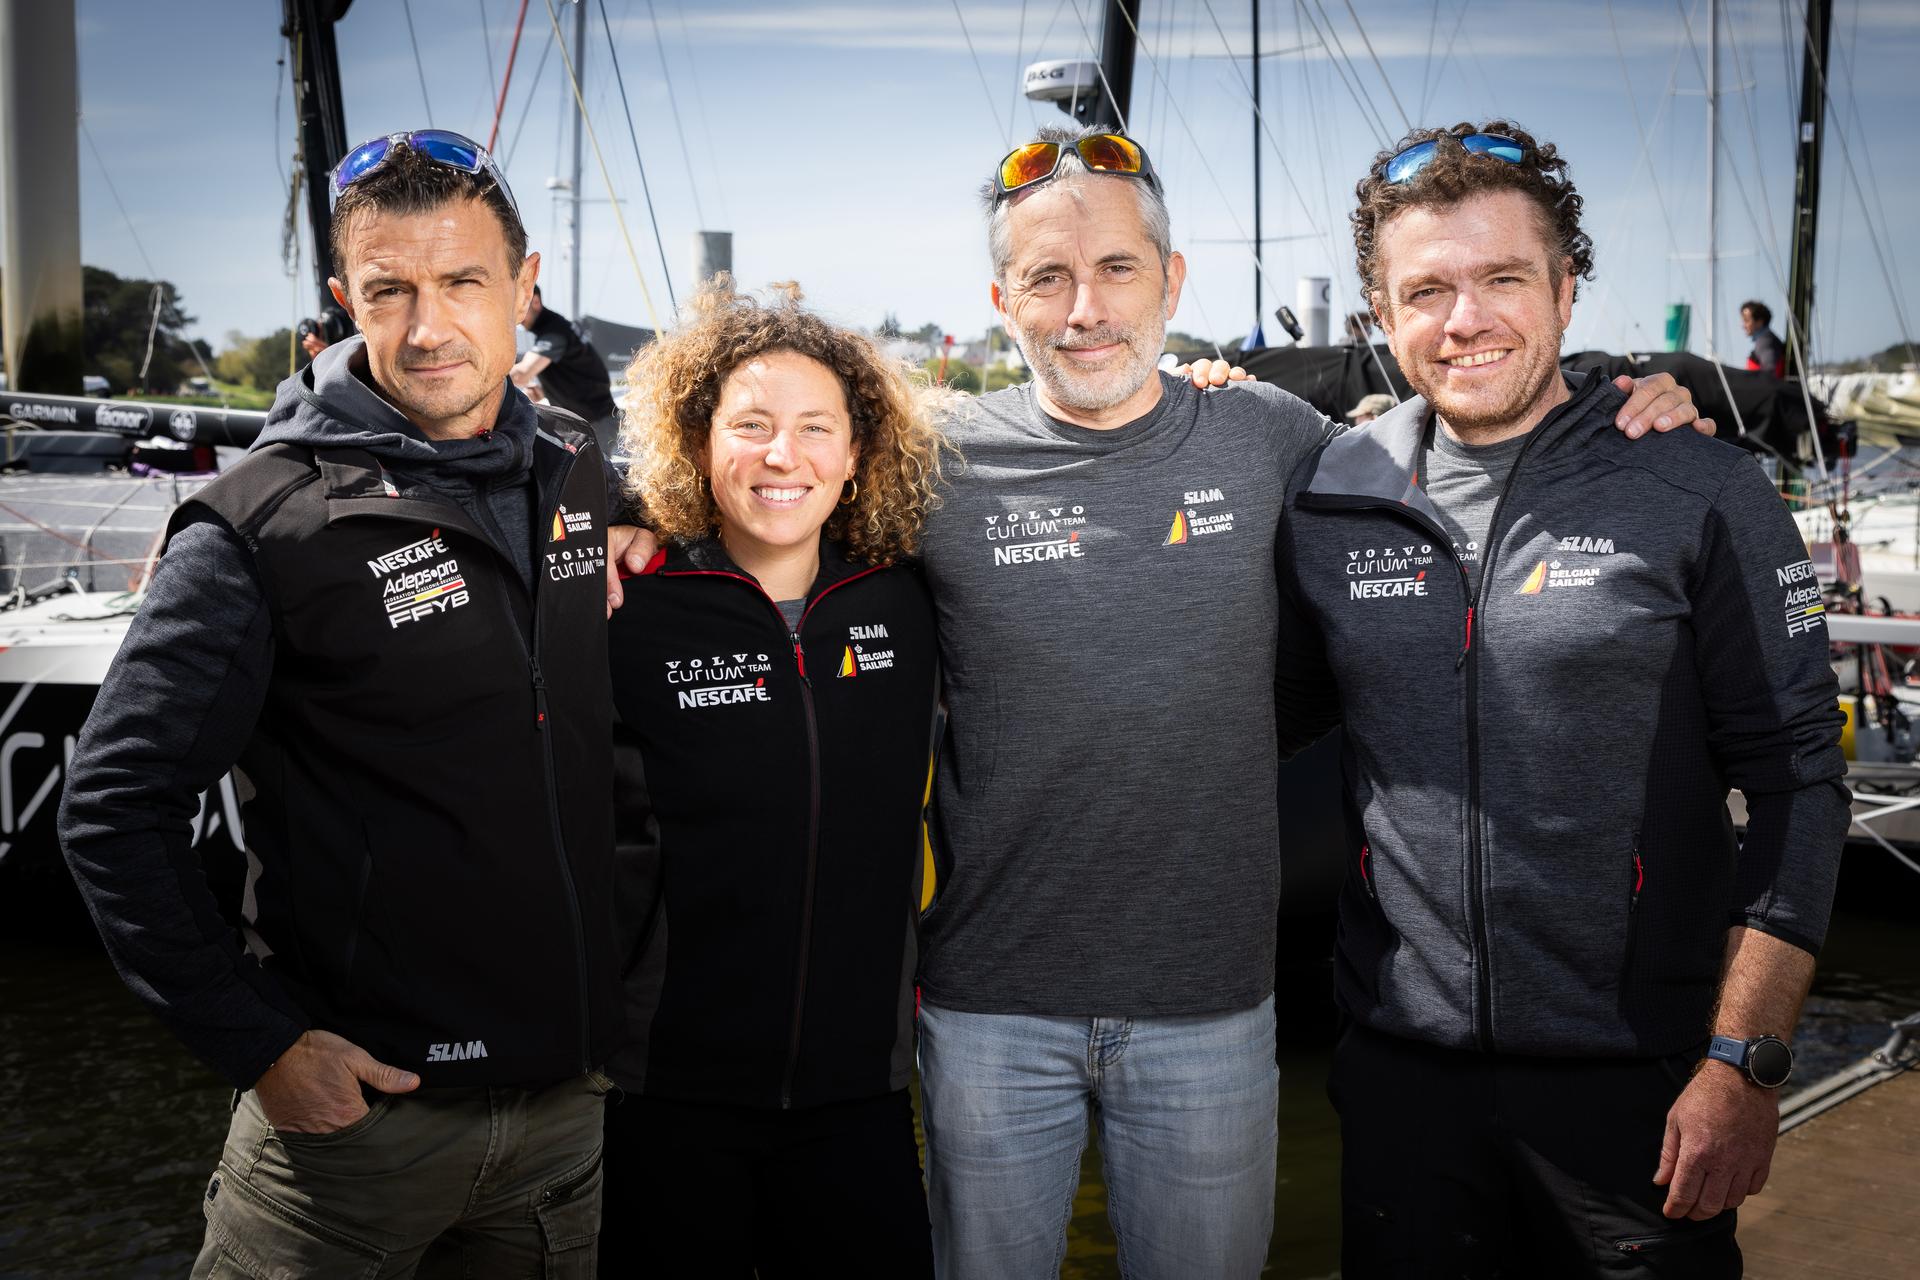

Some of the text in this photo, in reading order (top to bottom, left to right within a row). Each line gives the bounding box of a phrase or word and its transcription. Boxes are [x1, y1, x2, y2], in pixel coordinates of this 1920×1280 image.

[10, 403, 77, 423] GARMIN
[1184, 488, 1224, 505] SLAM
[563, 512, 591, 523] BELGIAN
[985, 505, 1084, 525] VOLVO
[1062, 517, 1086, 526] TEAM
[1189, 513, 1234, 527] BELGIAN
[566, 521, 592, 533] SAILING
[1192, 523, 1232, 536] SAILING
[367, 528, 449, 578] NESCAFÉ
[994, 531, 1085, 566] NESCAFÉ
[1348, 544, 1431, 560] VOLVO
[1558, 536, 1615, 554] SLAM
[546, 546, 603, 563] VOLVO
[1413, 556, 1433, 565] TEAM
[1550, 568, 1600, 578] BELGIAN
[1350, 571, 1428, 600] NESCAFÉ
[1549, 577, 1595, 587] SAILING
[389, 590, 470, 629] FFYB
[849, 624, 889, 640] SLAM
[665, 653, 769, 669] VOLVO
[857, 650, 894, 662] BELGIAN
[748, 664, 771, 672] TEAM
[860, 659, 893, 671] SAILING
[678, 677, 771, 709] NESCAFÉ
[427, 1040, 488, 1062] SLAM
